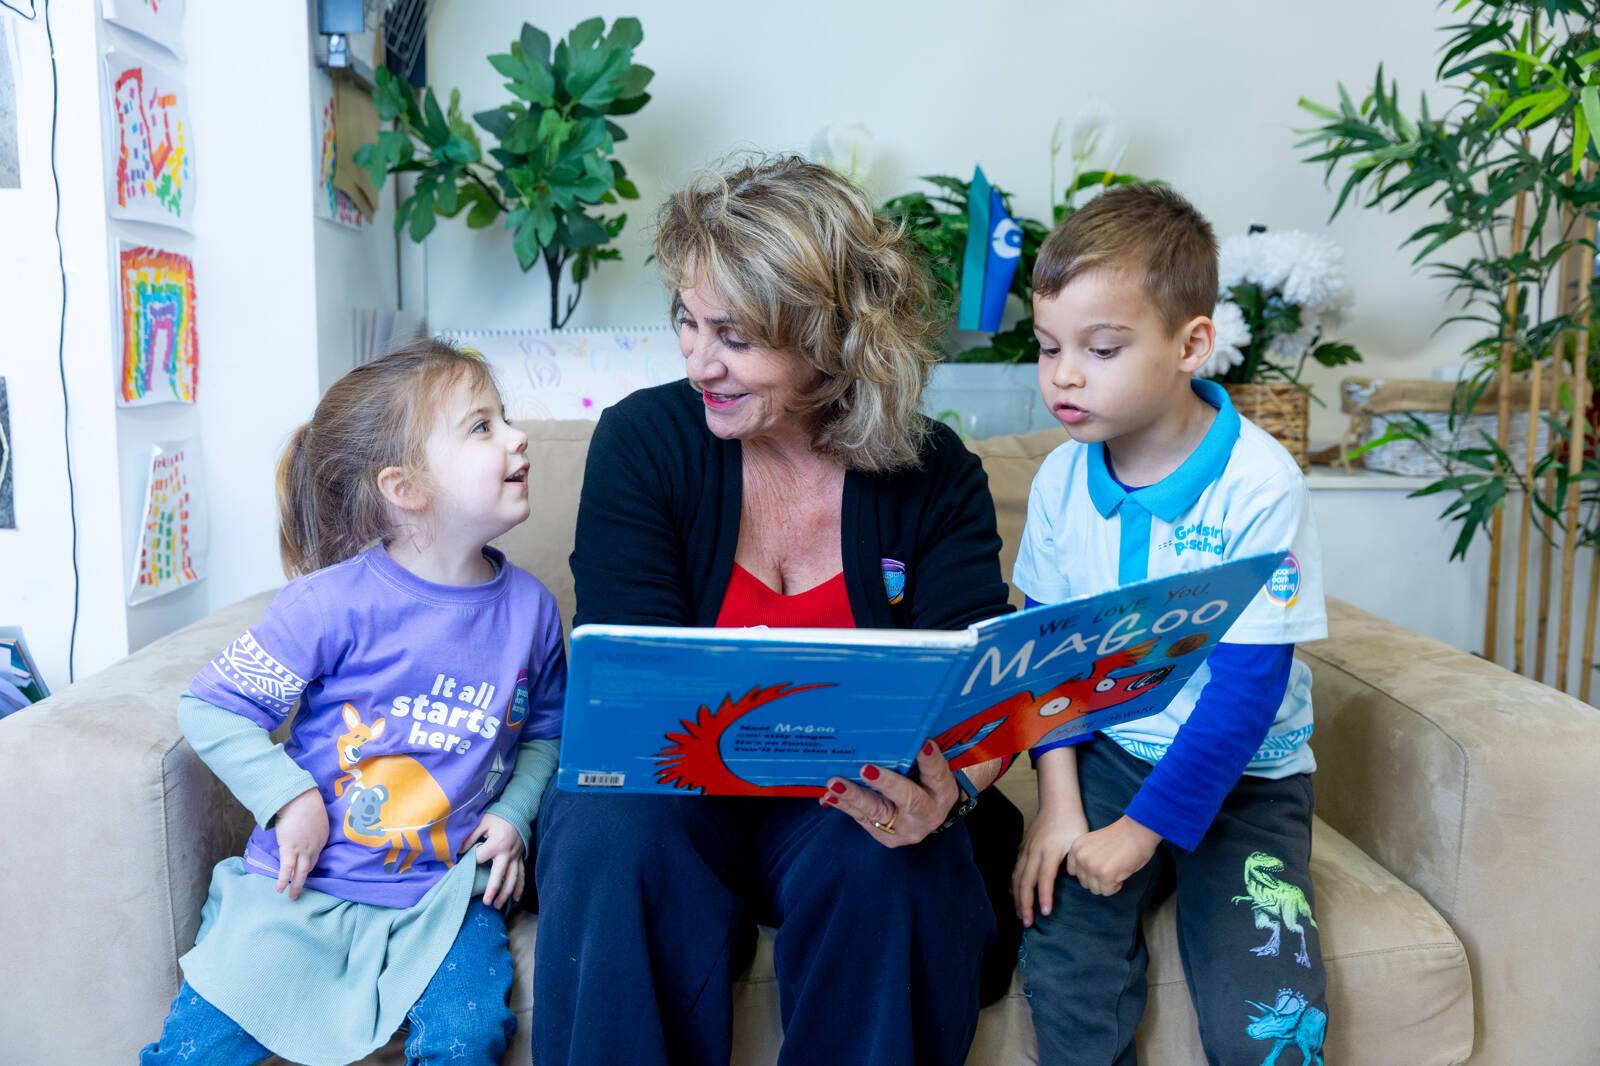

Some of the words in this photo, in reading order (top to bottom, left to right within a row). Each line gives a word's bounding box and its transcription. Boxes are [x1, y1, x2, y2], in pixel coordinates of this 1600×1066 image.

[1039, 615, 1078, 637] WE
[1092, 599, 1147, 624] LOVE
[960, 600, 1229, 696] MAGOO
[430, 673, 457, 698] It
[458, 681, 496, 710] all
[389, 693, 501, 740] starts
[407, 721, 472, 755] here
